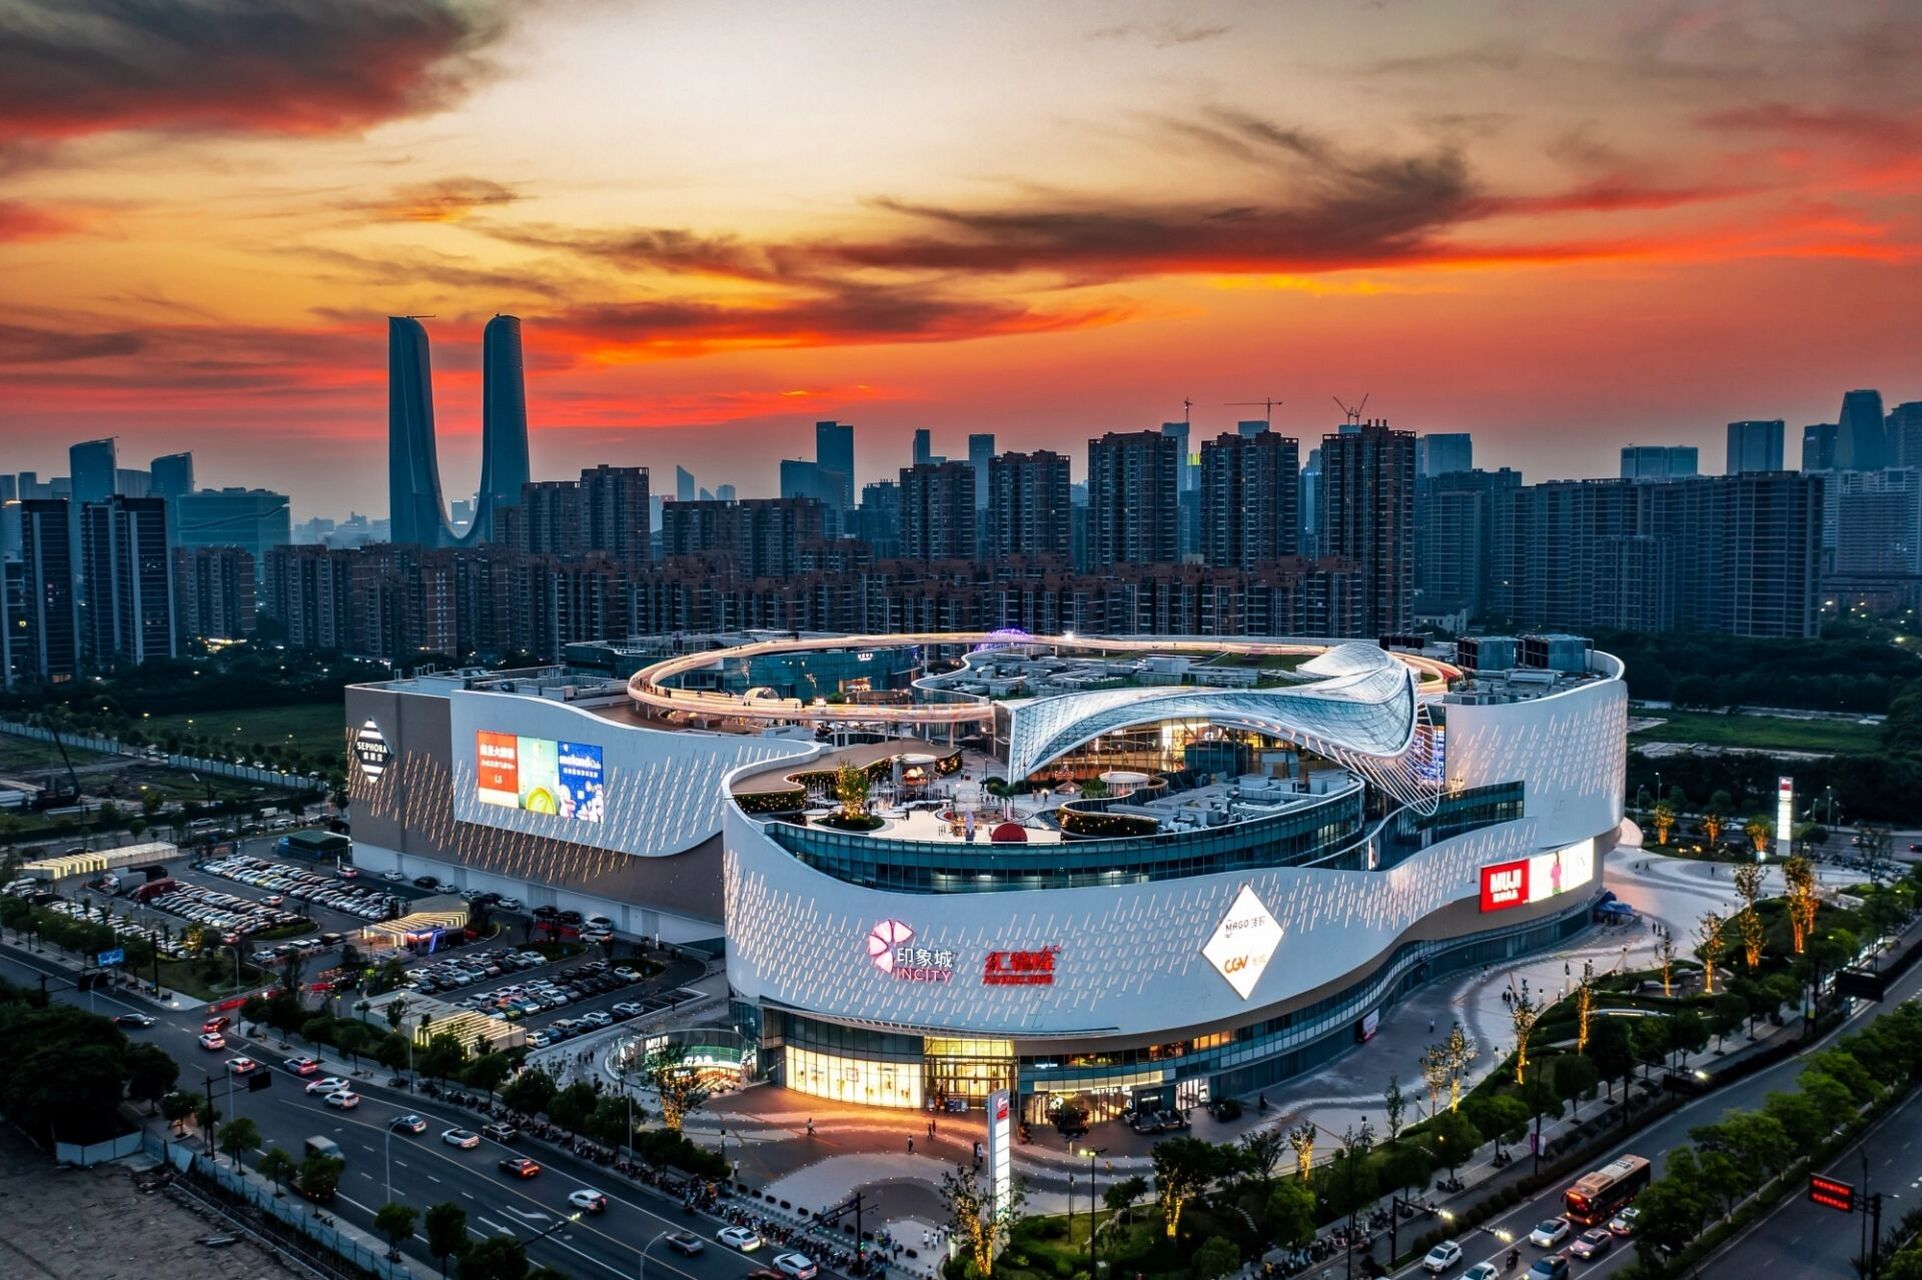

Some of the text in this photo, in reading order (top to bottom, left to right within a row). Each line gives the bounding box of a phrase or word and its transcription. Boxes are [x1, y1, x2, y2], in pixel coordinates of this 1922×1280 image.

[357, 741, 388, 754] SEPHORA
[1490, 869, 1522, 893] MUJI
[897, 947, 953, 968] 印象城
[1225, 954, 1249, 974] CGV
[896, 967, 952, 983] INCITY
